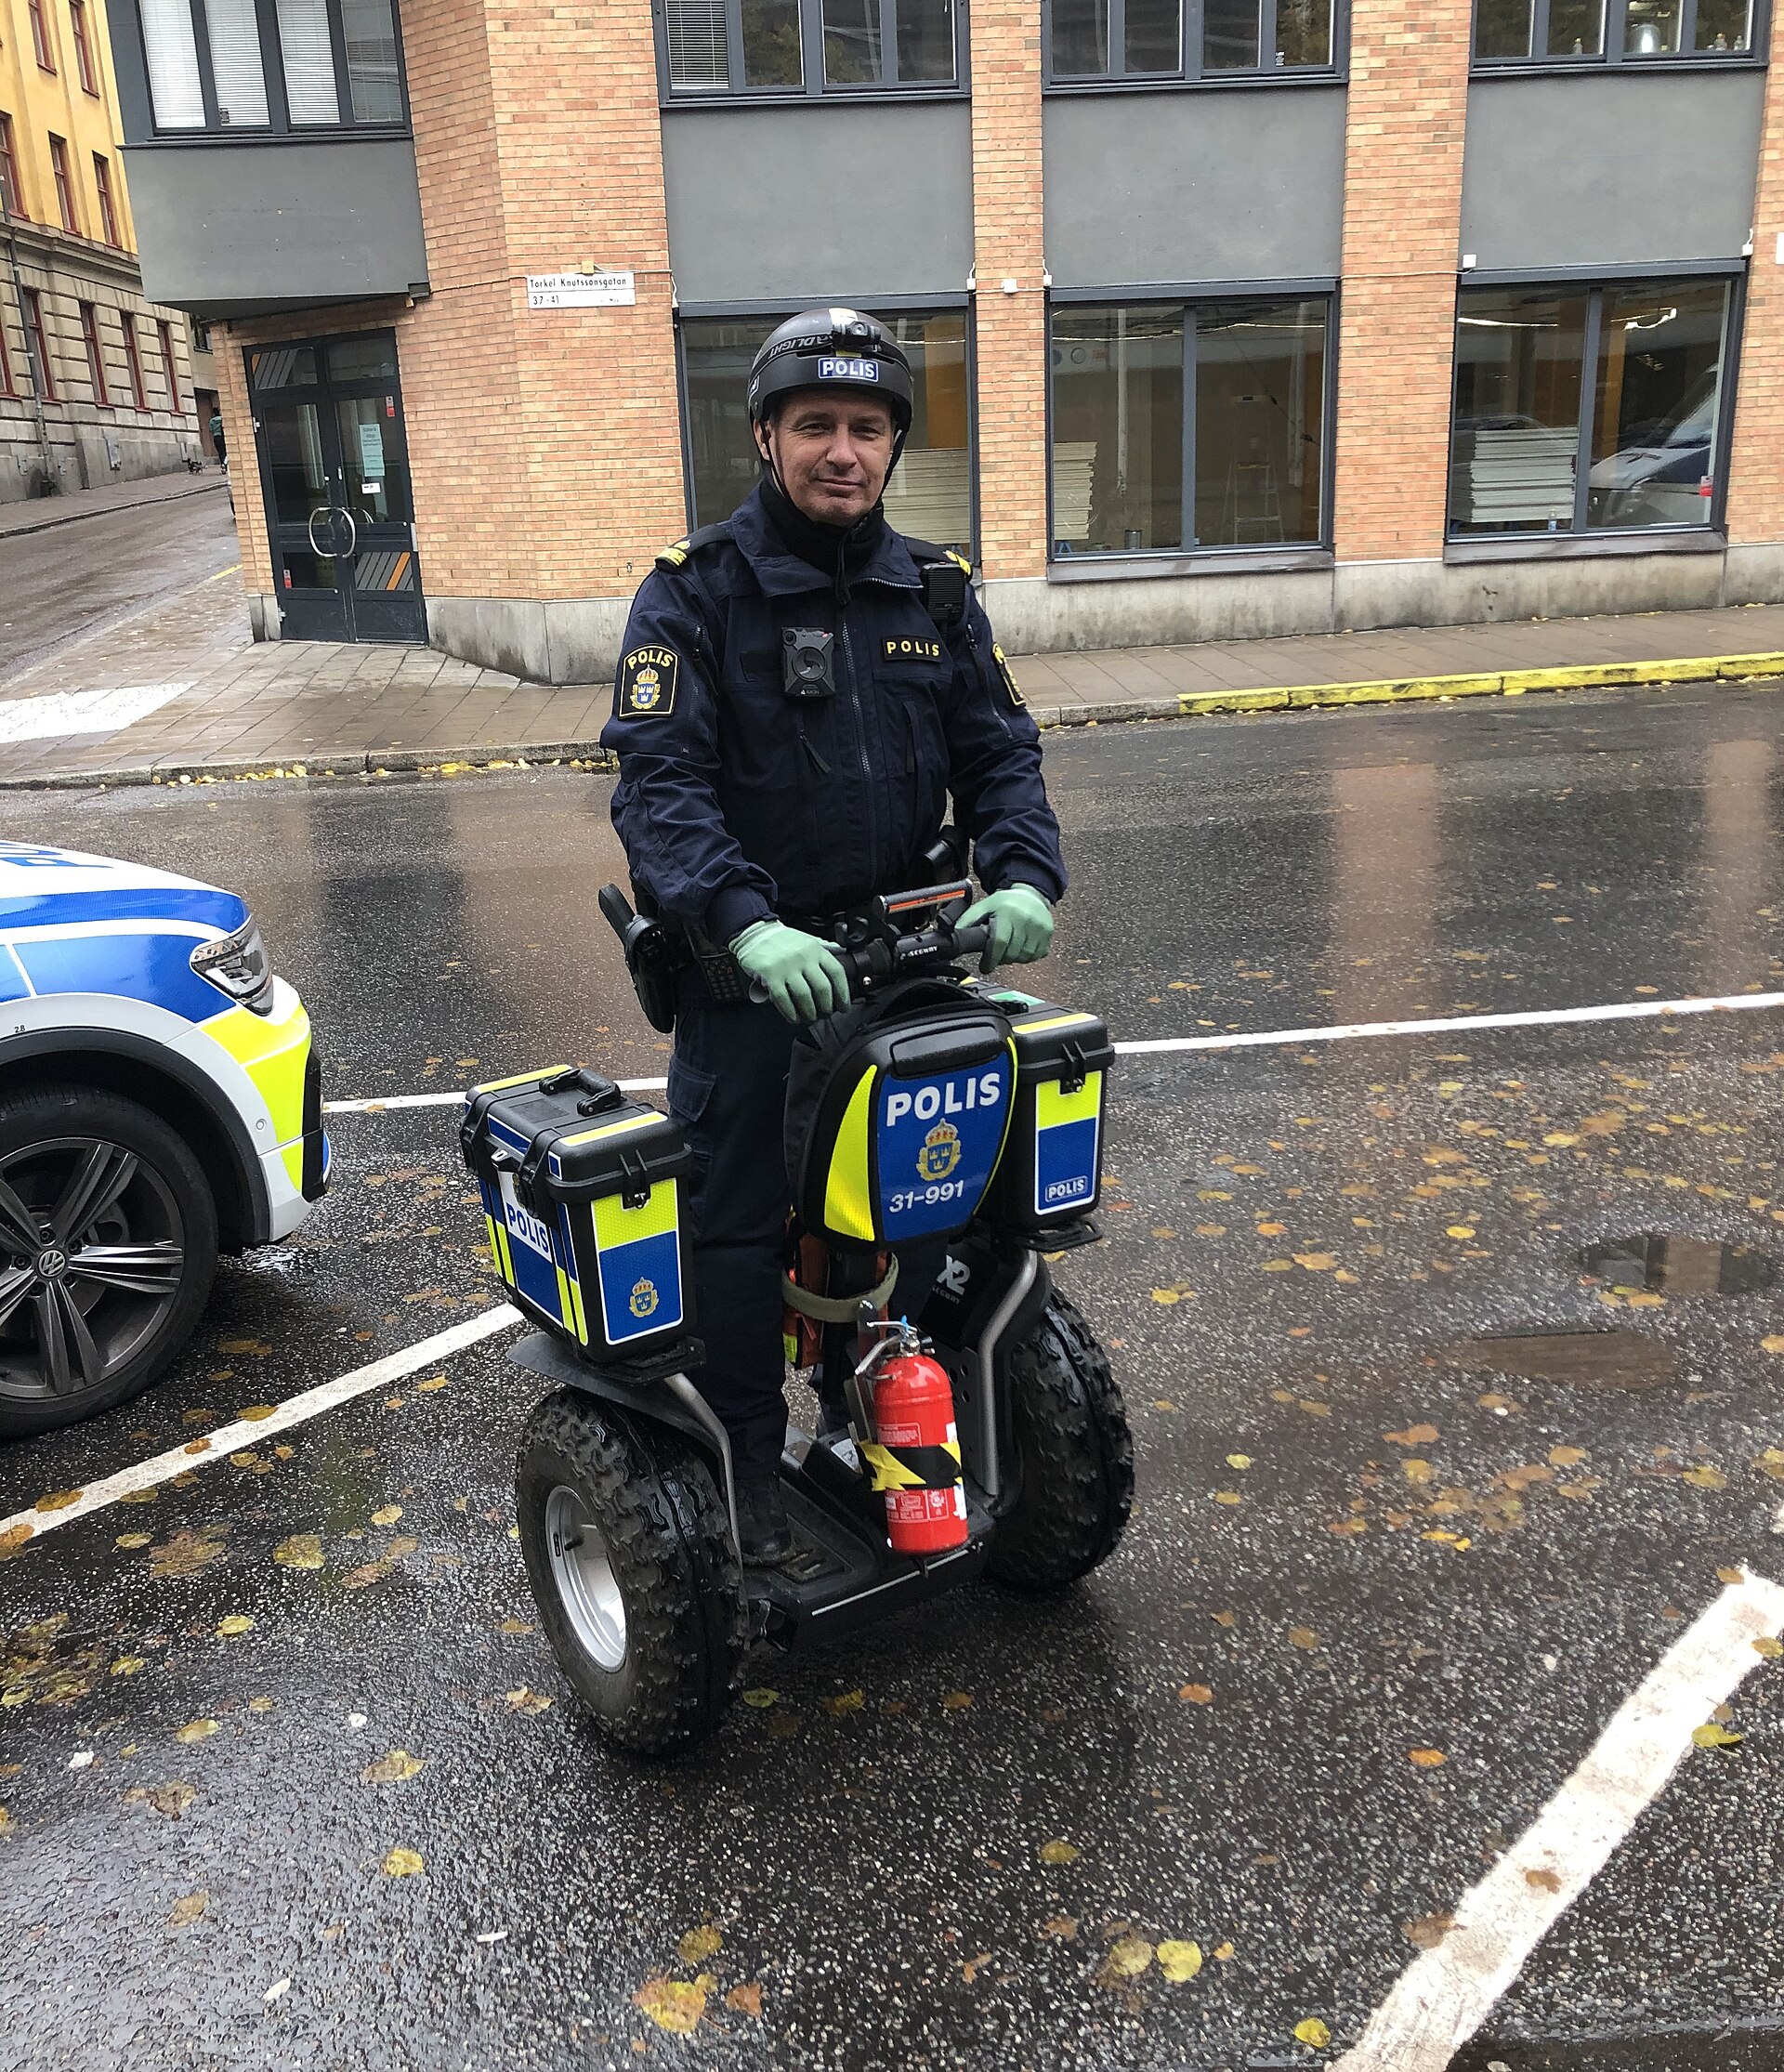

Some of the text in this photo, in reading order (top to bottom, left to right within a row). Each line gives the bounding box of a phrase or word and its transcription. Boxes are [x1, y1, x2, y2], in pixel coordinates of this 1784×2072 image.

[530, 278, 627, 288] Torkel Knutssonsgatan
[768, 334, 832, 360] ADLIGHT
[822, 361, 875, 378] POLIS
[886, 640, 939, 657] POLIS
[627, 649, 674, 670] POLIS
[886, 1072, 1001, 1128] POLIS
[889, 1180, 964, 1214] 31-991
[1048, 1179, 1085, 1200] POLIS
[506, 1201, 549, 1253] POLIS
